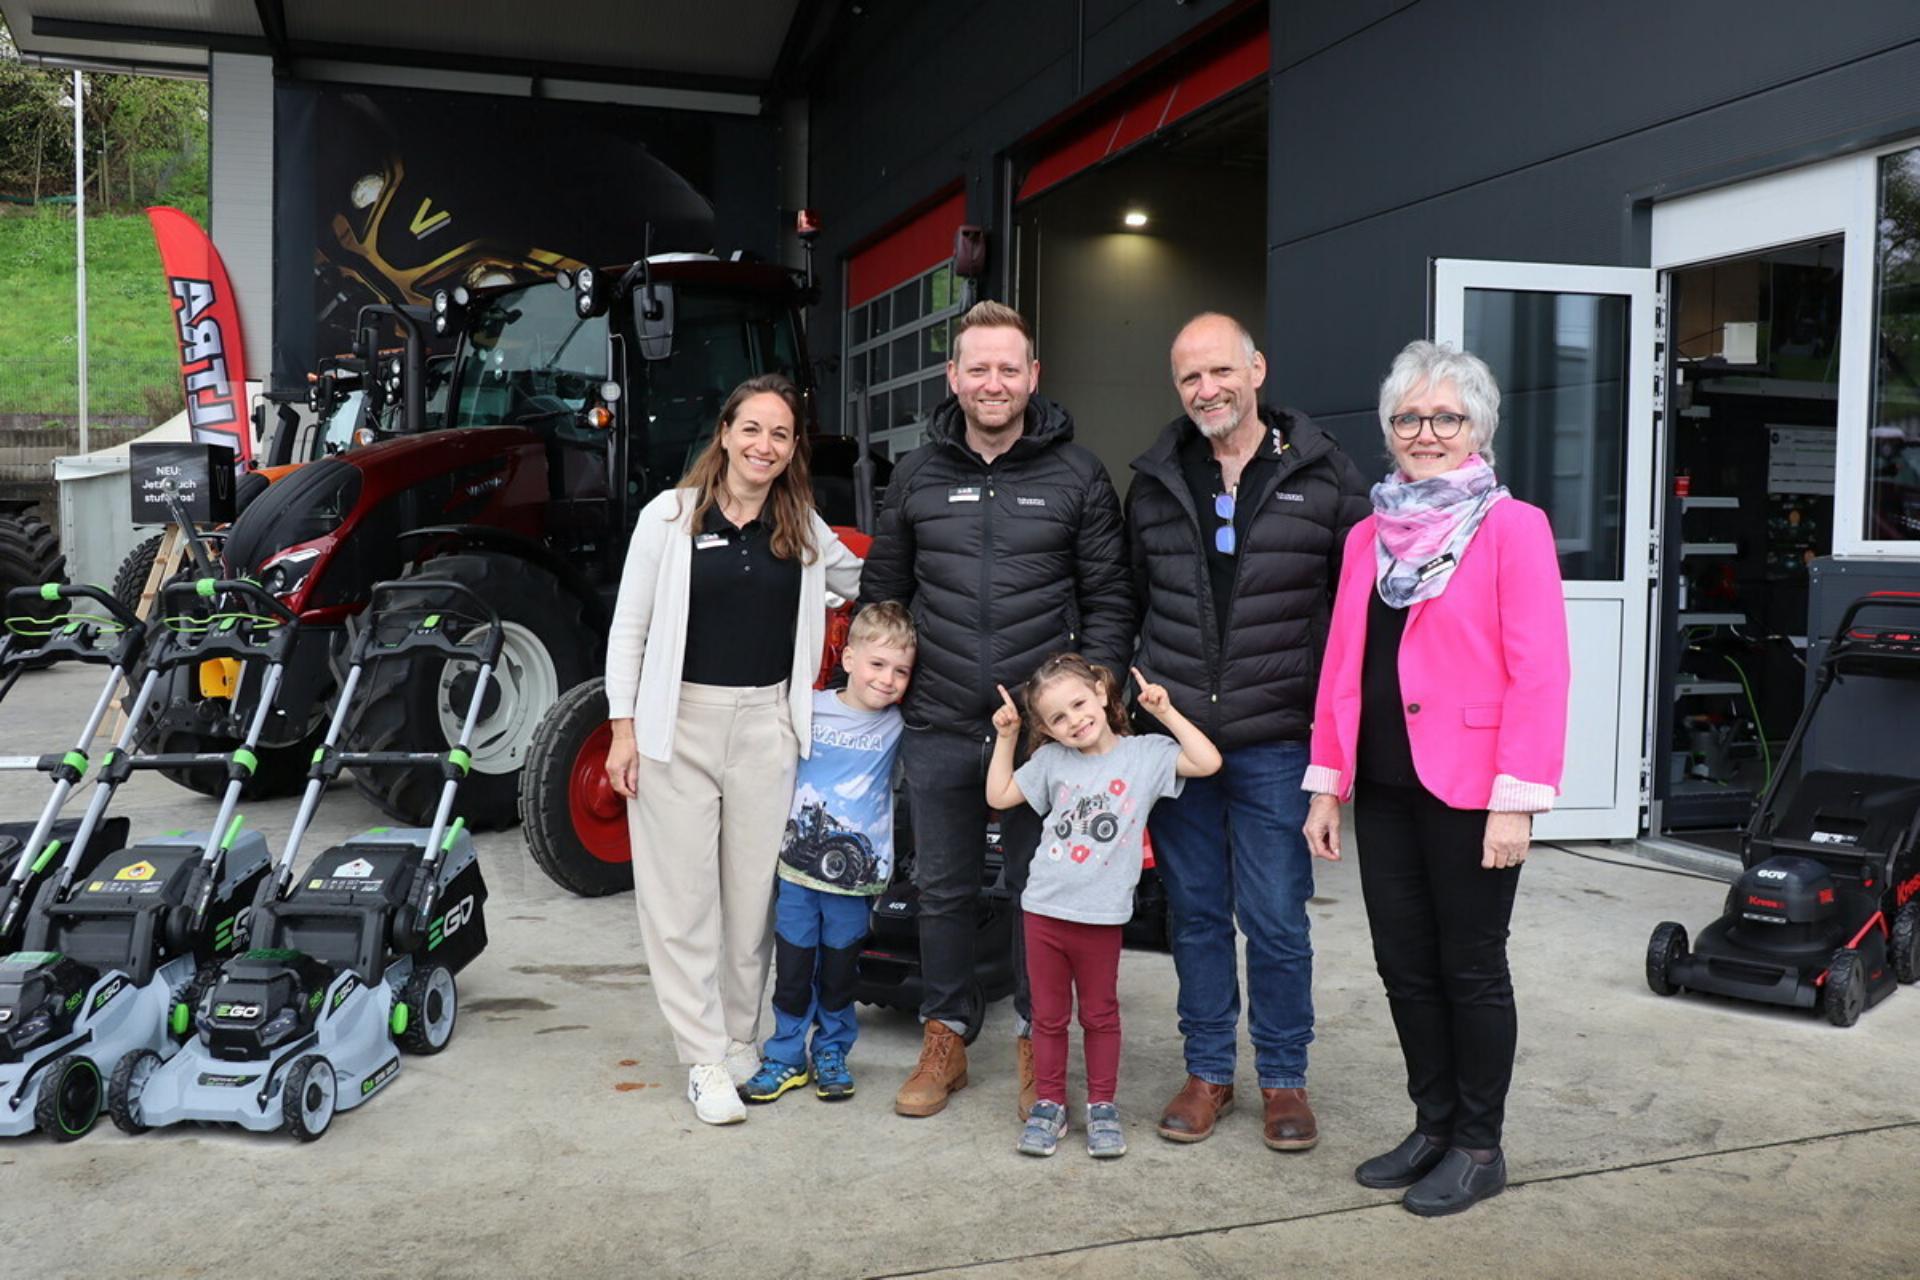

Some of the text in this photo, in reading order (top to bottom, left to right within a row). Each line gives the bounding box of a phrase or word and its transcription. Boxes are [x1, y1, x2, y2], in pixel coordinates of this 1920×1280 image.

[155, 465, 182, 476] NEU:
[428, 894, 474, 952] EGO
[215, 1003, 260, 1018] EGO
